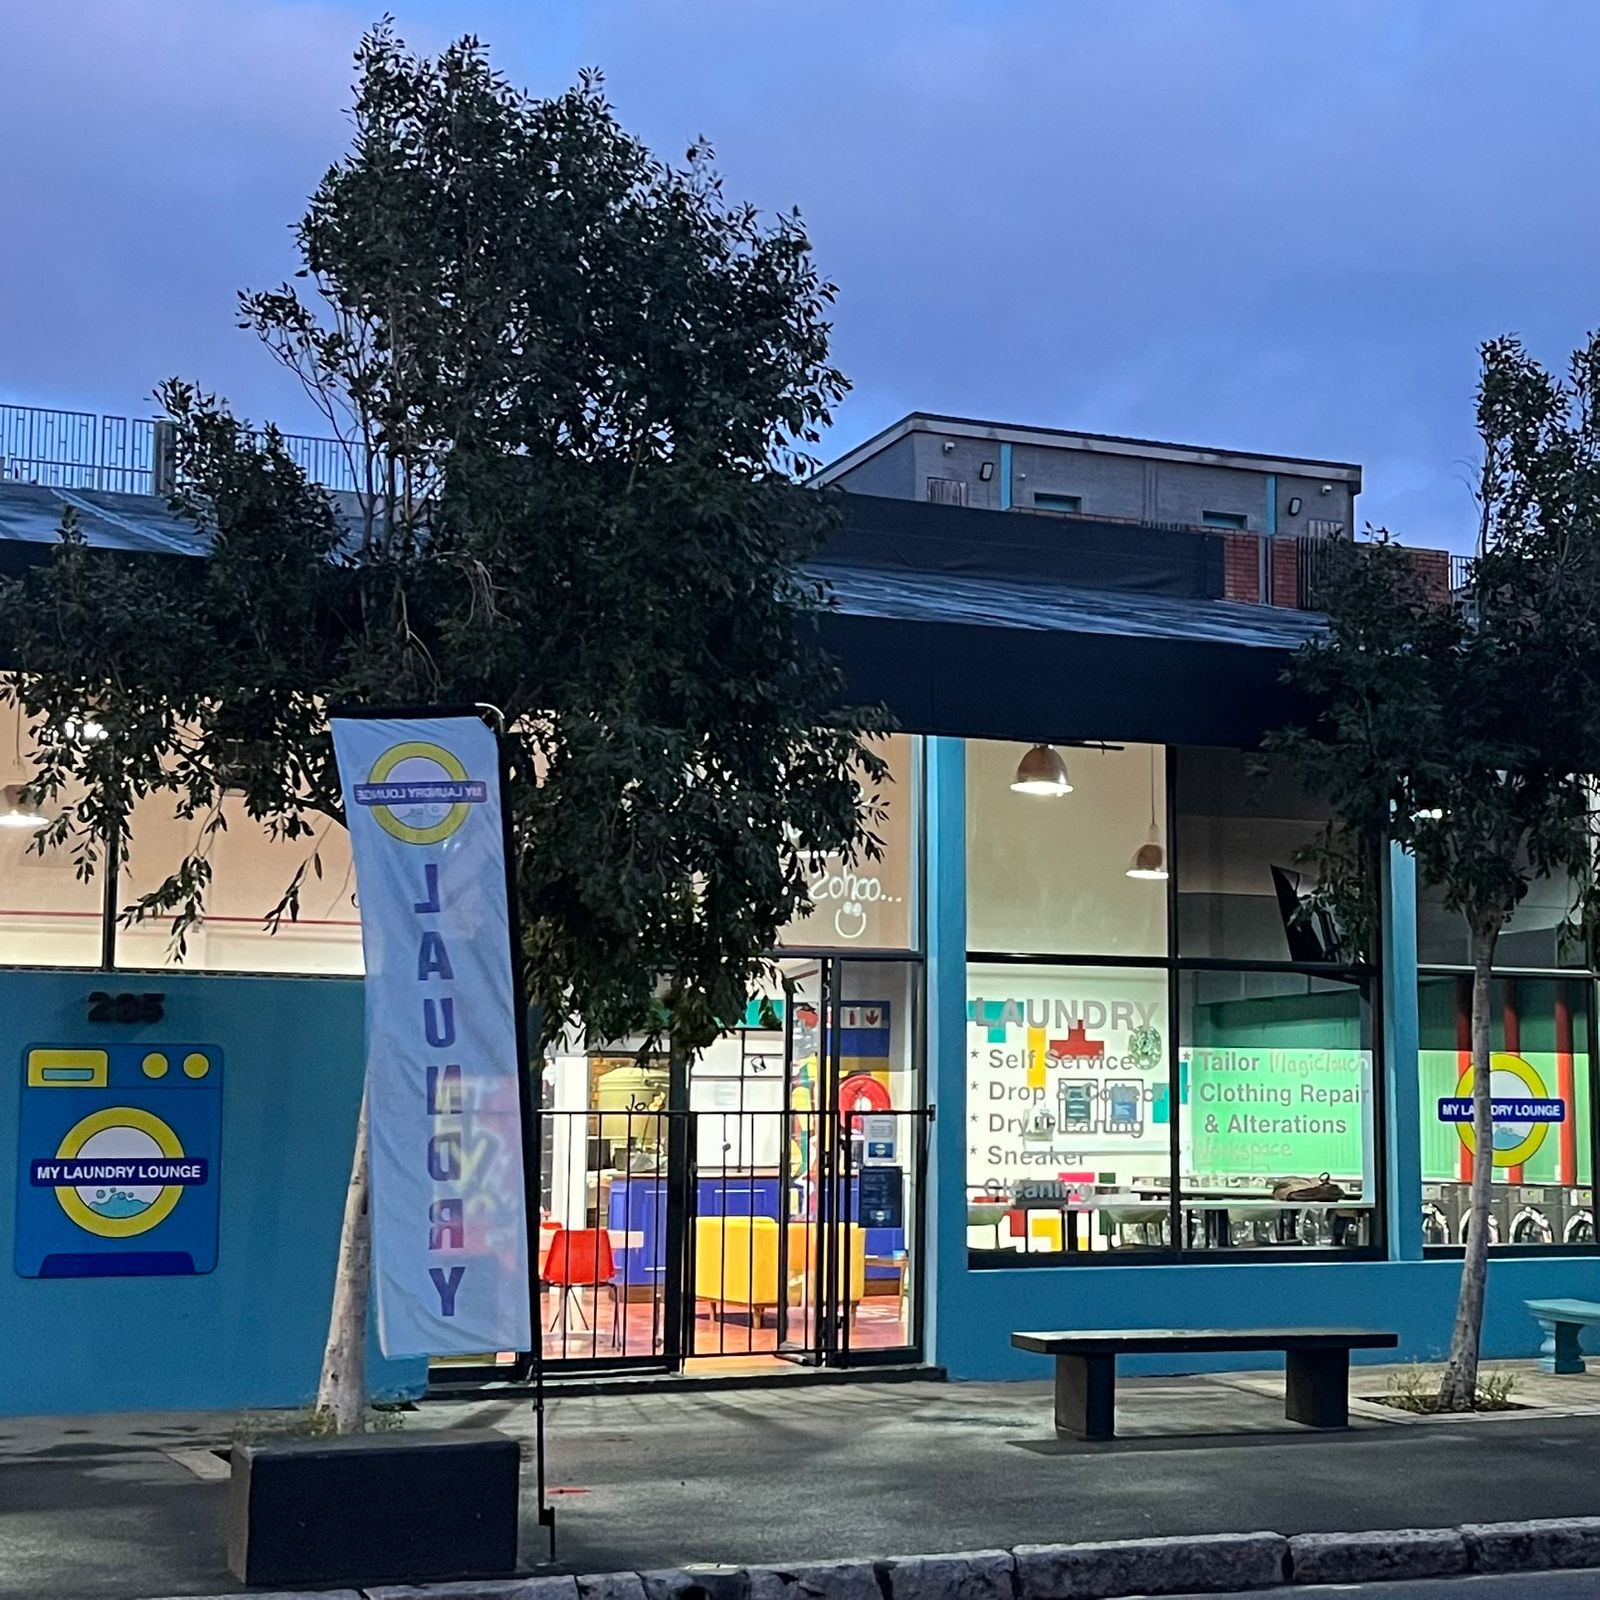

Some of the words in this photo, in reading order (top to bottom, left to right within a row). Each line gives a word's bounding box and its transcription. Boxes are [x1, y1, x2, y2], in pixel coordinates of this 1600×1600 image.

[975, 998, 1159, 1031] LAUNDRY
[989, 1048, 1036, 1069] Self
[1044, 1050, 1132, 1071] Service
[1200, 1052, 1259, 1071] Tailor
[989, 1081, 1046, 1105] Drop
[1200, 1083, 1291, 1107] Clothing
[1301, 1084, 1370, 1107] Repair
[1442, 1104, 1459, 1116] MY
[1461, 1104, 1513, 1117] LADRY
[1515, 1104, 1560, 1117] LOUNGE
[989, 1113, 1029, 1137] Dry
[1205, 1114, 1219, 1133] &
[1227, 1114, 1347, 1134] Alterations
[988, 1146, 1086, 1166] Sneaker
[37, 1166, 60, 1179] MY
[64, 1166, 134, 1179] LAUNDRY
[139, 1165, 201, 1178] LOUNGE
